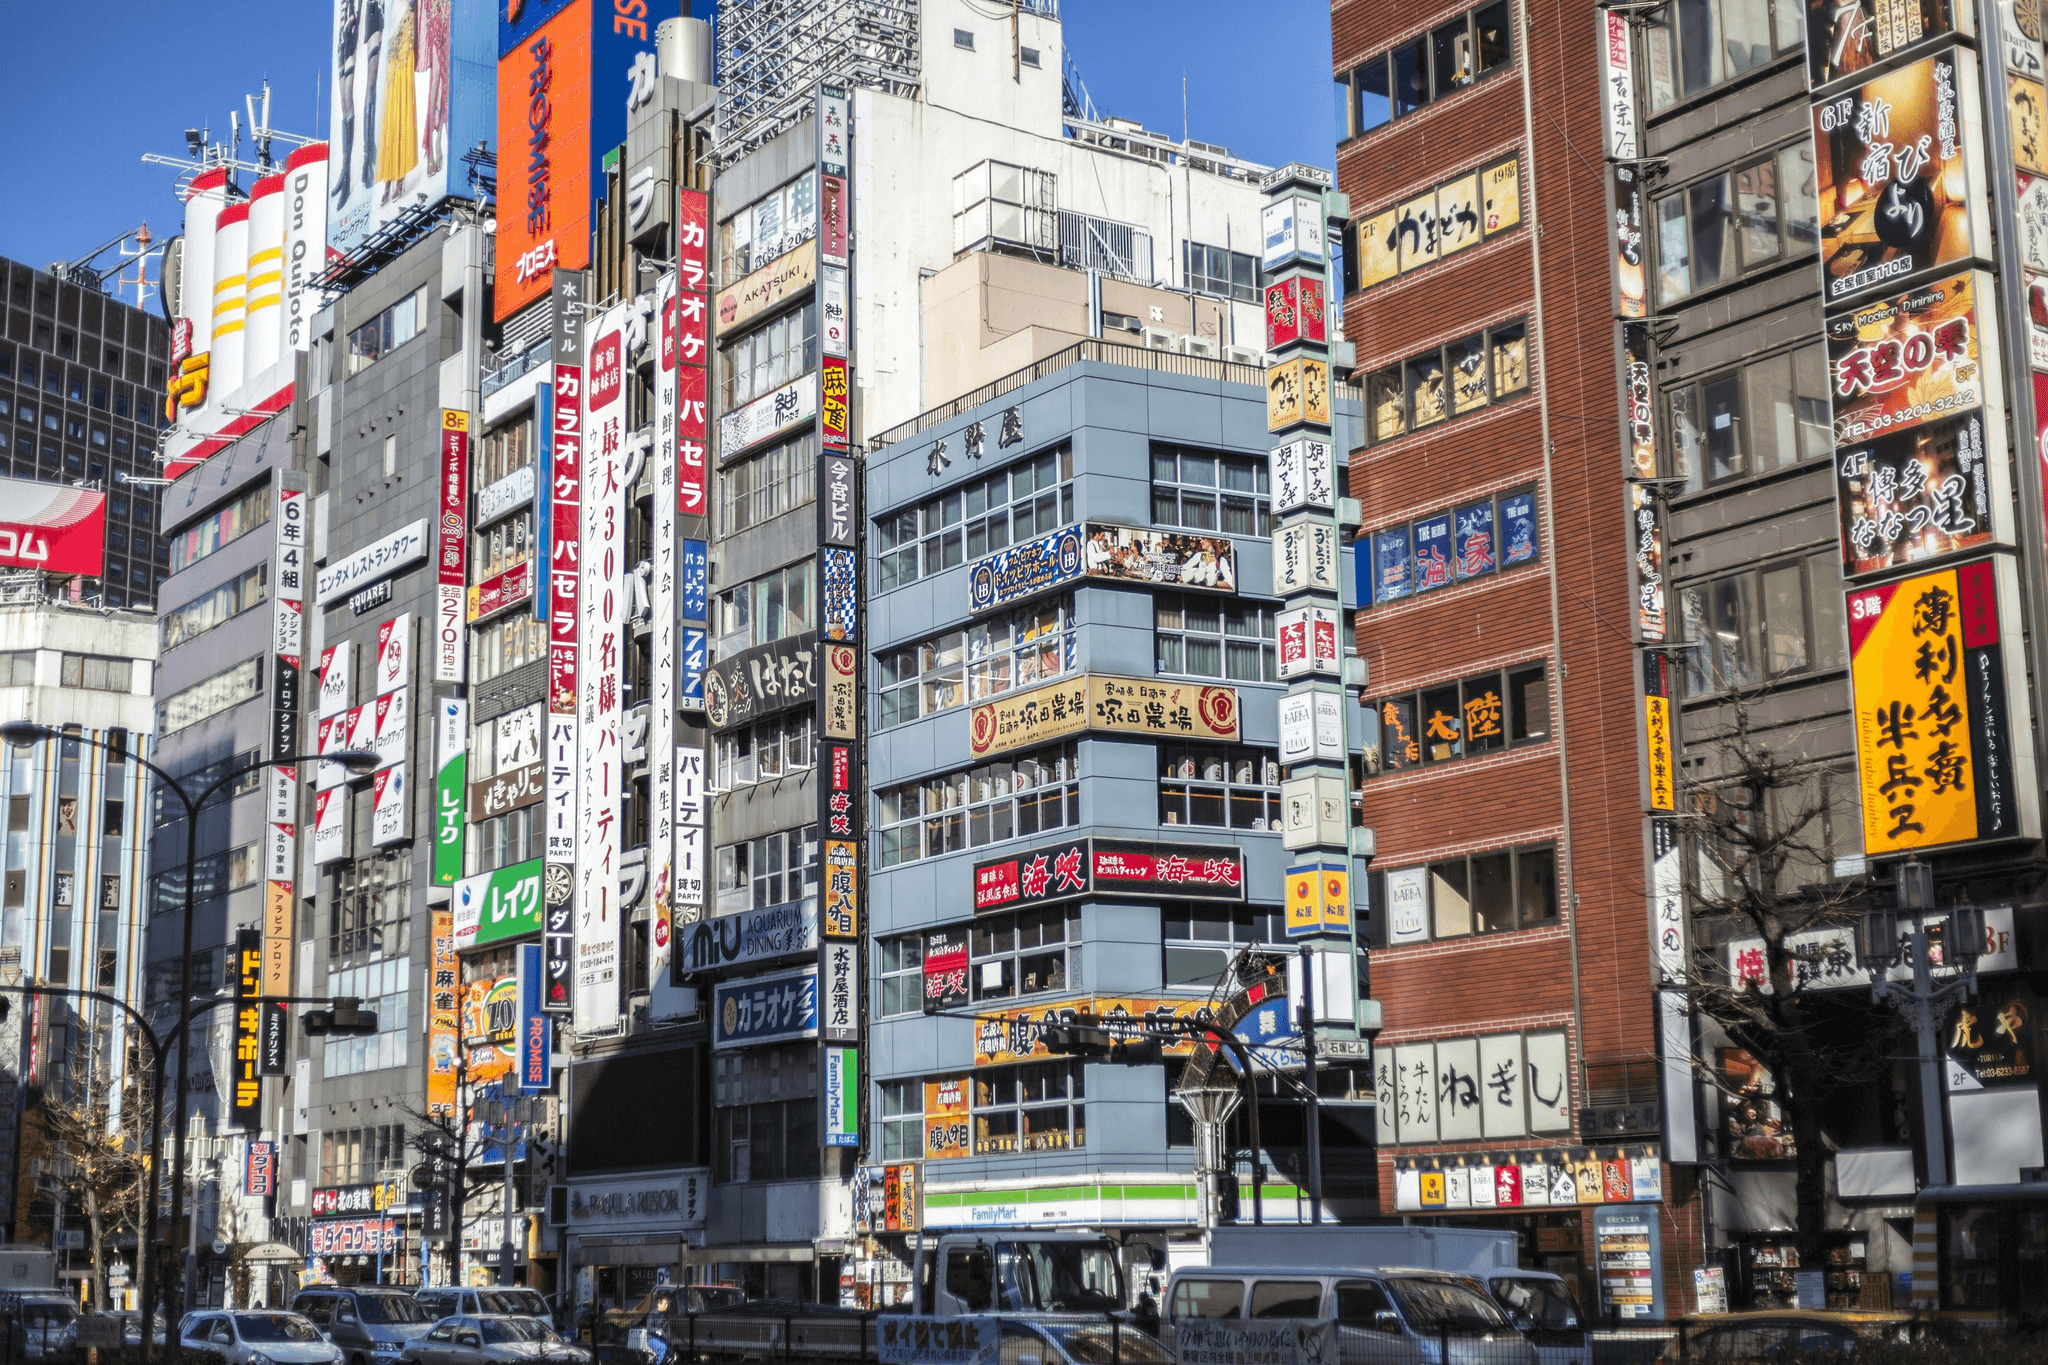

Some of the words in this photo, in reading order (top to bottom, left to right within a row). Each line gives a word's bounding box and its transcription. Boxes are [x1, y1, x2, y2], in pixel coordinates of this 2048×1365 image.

[527, 36, 552, 236] PROMISE
[827, 164, 841, 174] 9F
[294, 172, 309, 230] Don
[287, 238, 309, 347] Quijote
[681, 221, 705, 359] カラオケ
[743, 265, 801, 306] AKATSUKI
[1858, 306, 1898, 327] Modern
[445, 412, 465, 429] 8F
[554, 374, 580, 498] カラオケ
[679, 398, 705, 508] パセラ
[830, 460, 850, 541] 今宮ビル
[349, 583, 384, 610] SQUARE
[551, 540, 578, 635] パセラ
[321, 653, 331, 668] 8F
[686, 630, 704, 695] 747
[440, 788, 460, 845] レイク
[549, 849, 573, 857] PARTY
[1022, 846, 1086, 897] 海峡
[1156, 853, 1240, 887] 海峡
[491, 874, 540, 924] レイク
[677, 892, 702, 900] PARTY
[549, 910, 570, 979] ダーツ
[737, 985, 797, 1032] カラオケ
[834, 1029, 847, 1038] 1F
[528, 1016, 543, 1083] PROMISE
[829, 1054, 840, 1127] FamilyMart
[1953, 1073, 1967, 1086] 2F
[312, 1194, 325, 1210] 4F
[971, 1205, 1018, 1224] FamilyMart
